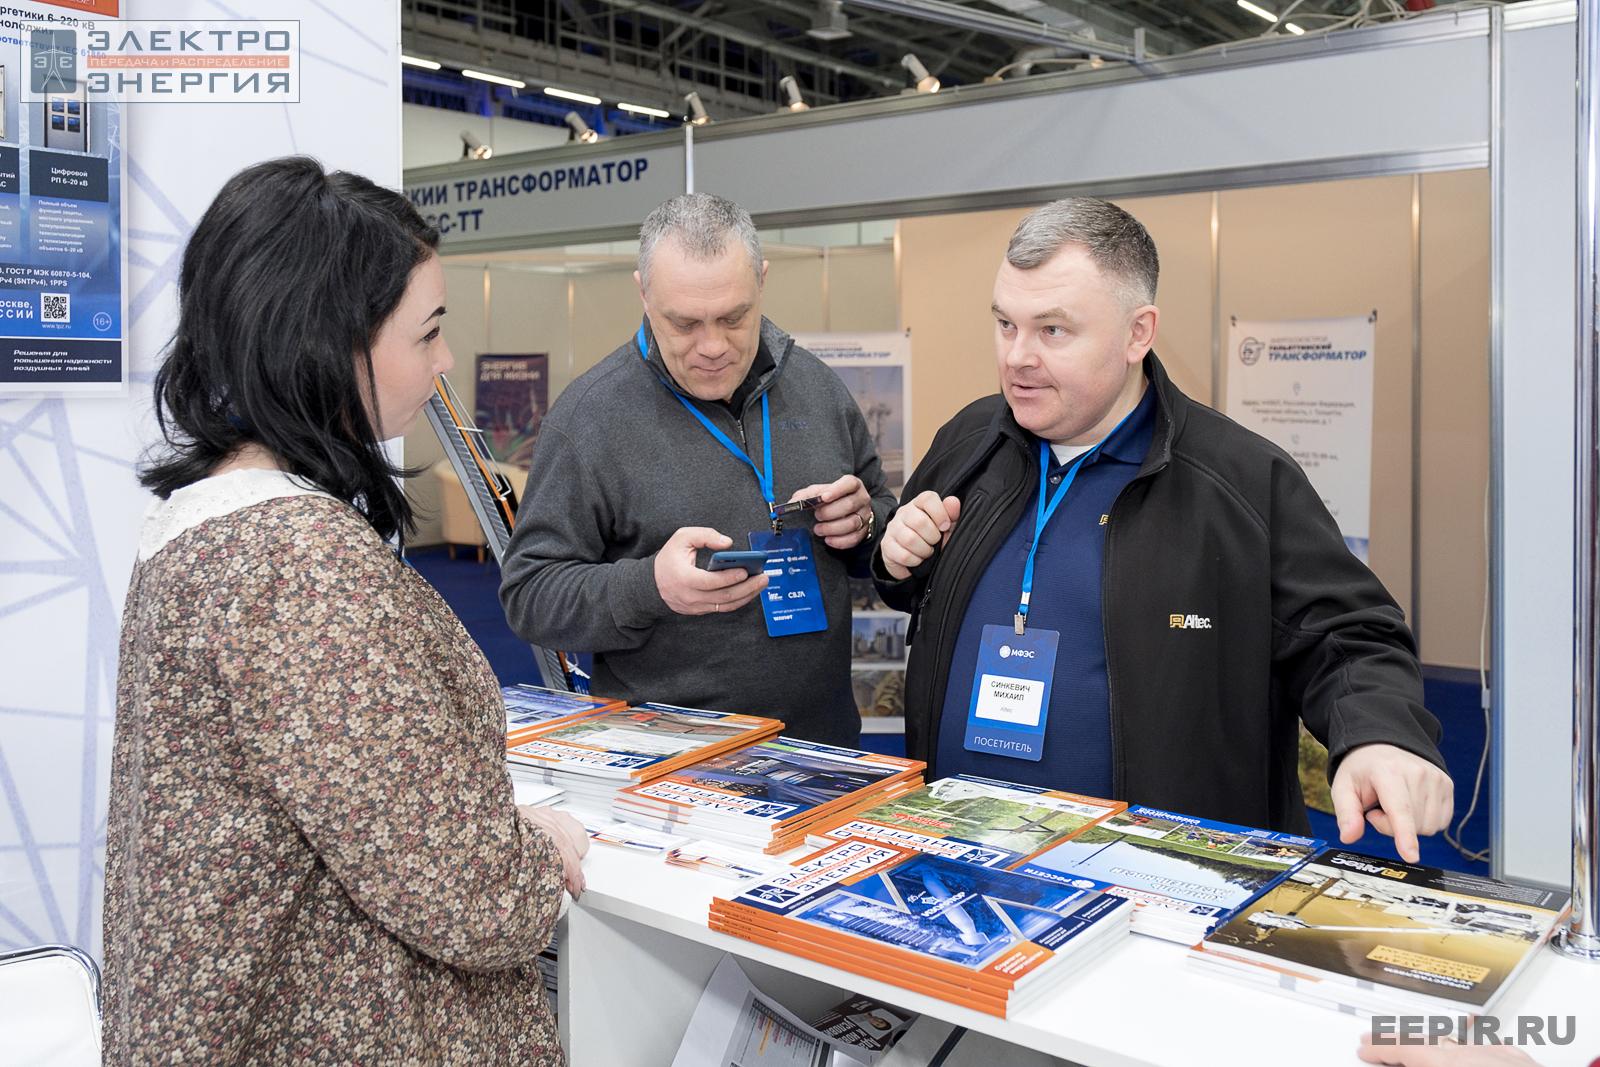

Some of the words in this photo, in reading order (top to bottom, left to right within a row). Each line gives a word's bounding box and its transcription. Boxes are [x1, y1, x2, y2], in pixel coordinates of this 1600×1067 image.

[51, 167, 88, 177] Цифровой
[454, 157, 649, 202] ТРАНСФОРМАТОР
[79, 179, 88, 187] кВ
[6, 267, 25, 275] ГОСТ
[1268, 350, 1367, 361] ТРАНСФОРМАТОР
[1011, 649, 1035, 659] МФЭС
[991, 680, 1031, 693] СИНКЕВИЧ
[993, 690, 1024, 702] МИХАИЛ
[974, 736, 1032, 753] ПОСЕТИТЕЛЬ
[641, 788, 743, 813] ЭЛЕКТРО
[659, 783, 760, 806] ЭНЕРГИЯ
[850, 823, 968, 851] ЭНЕРГИЯ
[772, 843, 868, 885] ЭЛЕКТРО
[798, 848, 892, 892] ЭНЕРГИЯ
[1023, 867, 1072, 884] РОССЕТИ
